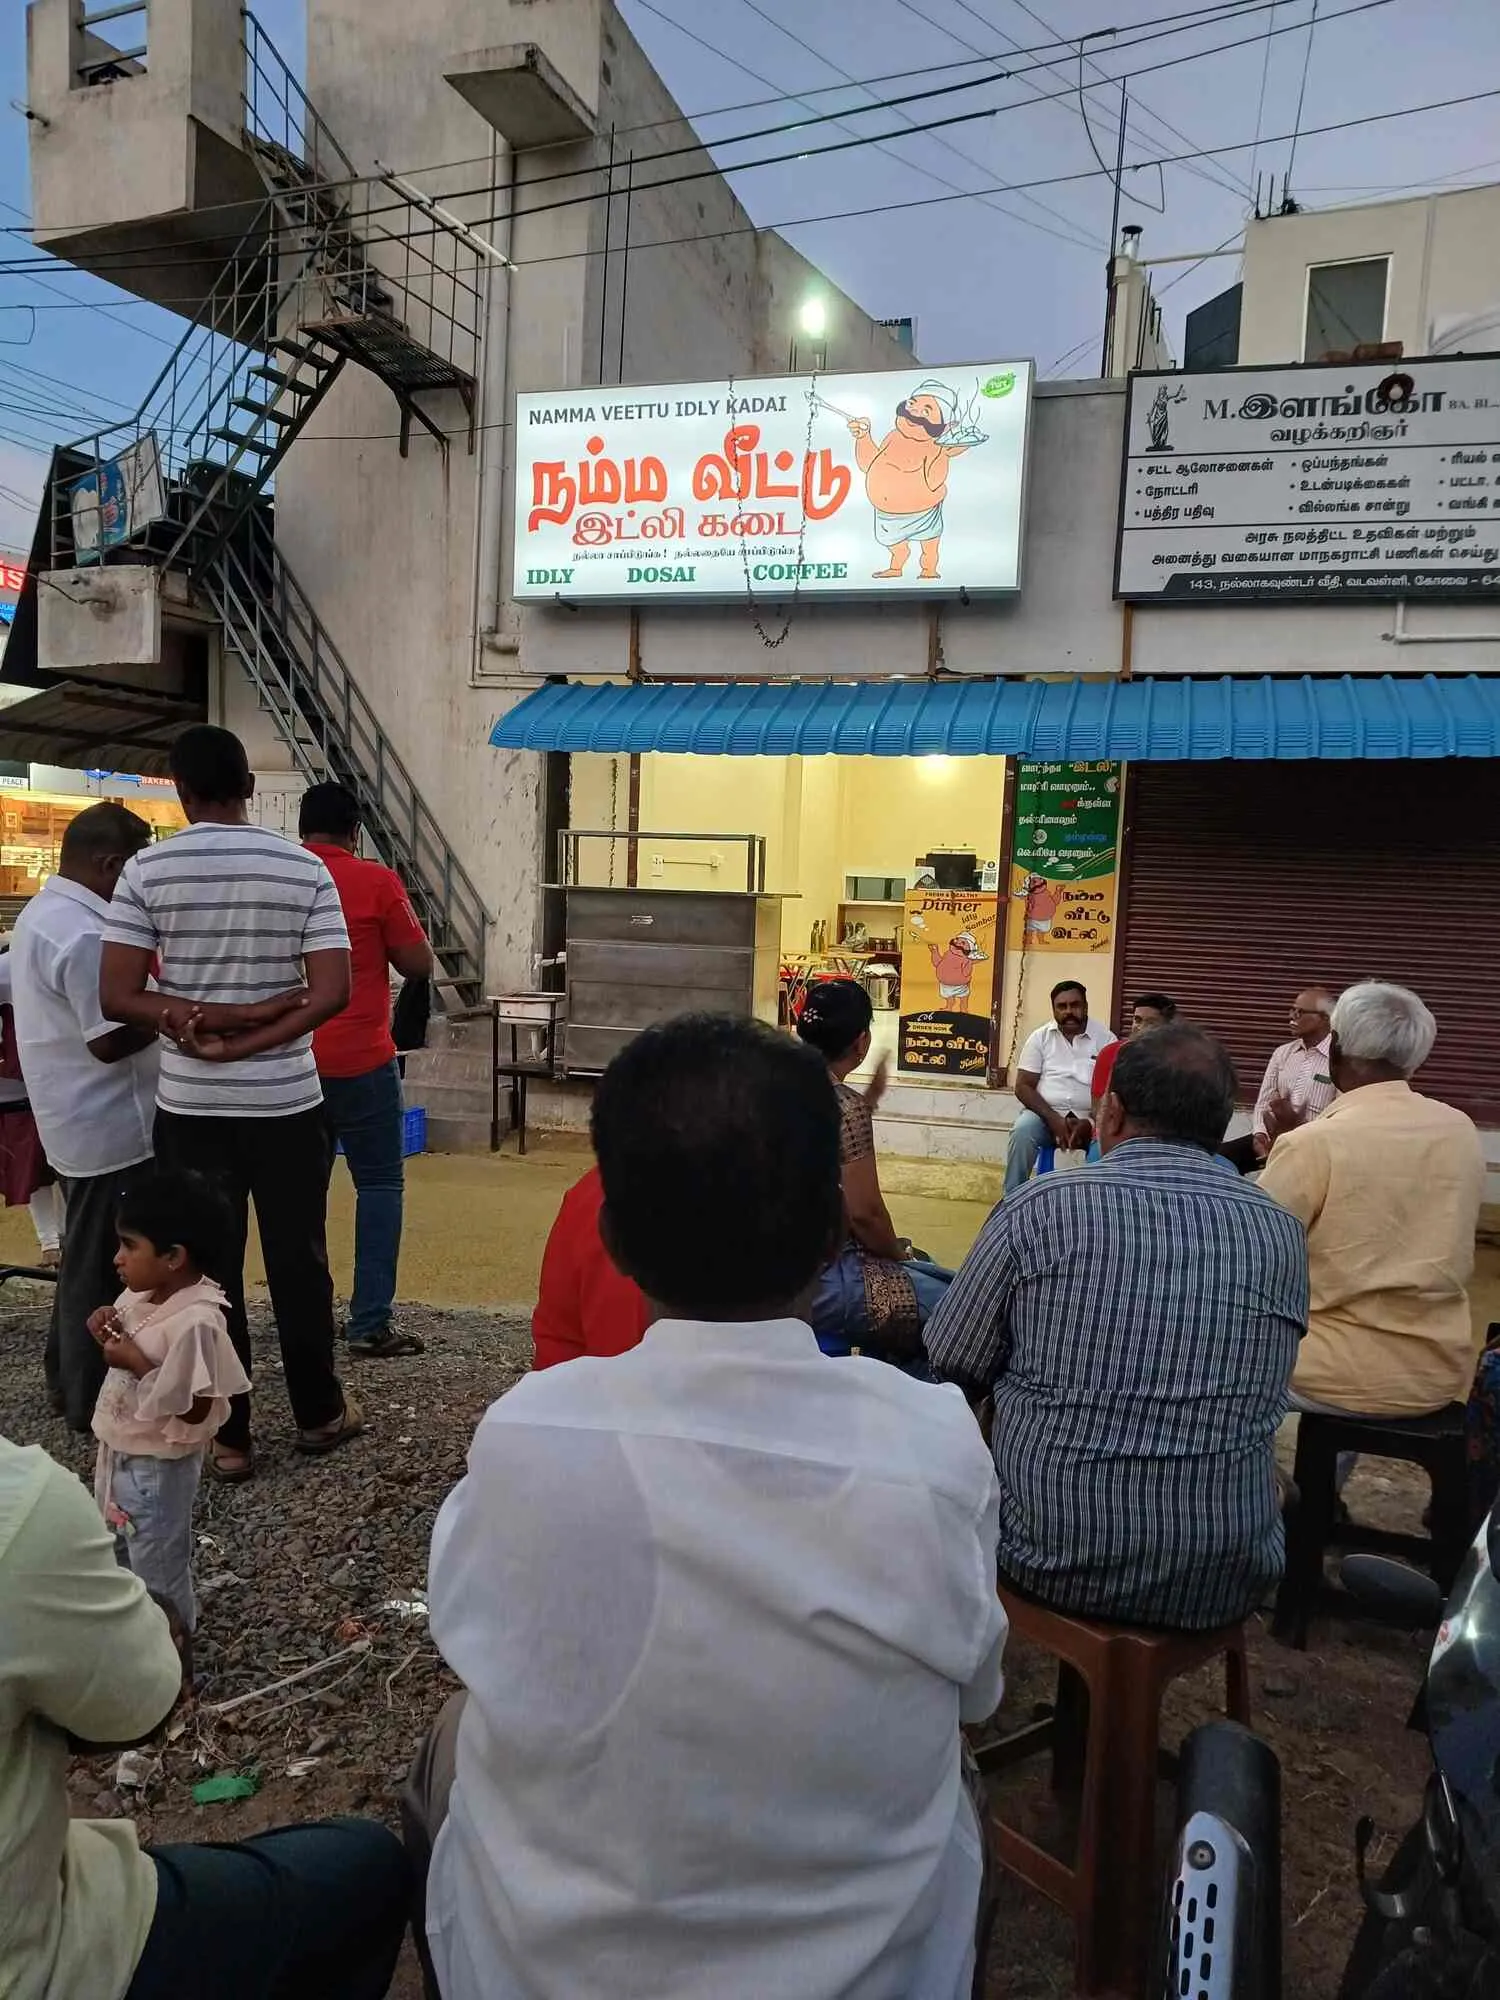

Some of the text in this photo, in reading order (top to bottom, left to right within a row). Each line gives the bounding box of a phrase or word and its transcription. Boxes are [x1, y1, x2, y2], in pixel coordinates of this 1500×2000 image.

[529, 396, 787, 425] NAMMA VEETTU IDLY KADAI
[1270, 419, 1409, 445] வழக்கறிஞர்
[1146, 458, 1275, 476] சட்ட ஆலோசனைகள்
[1302, 453, 1389, 473] ஒப்பந்தங்கள்
[528, 424, 852, 533] நம்ம வீட்டு
[1299, 475, 1411, 492] உடன்படிக்கைகள்
[1145, 482, 1198, 499] நோட்டரி
[1143, 504, 1215, 521] பத்திர பதிவு
[1365, 498, 1411, 516] சான்று
[572, 507, 805, 546] இட்லி கடை
[1245, 532, 1280, 545] அரசு
[1352, 525, 1420, 543] உதவிகள்
[1424, 525, 1477, 543] மற்றும்
[1151, 551, 1217, 568] அனைத்து
[1221, 550, 1295, 564] வகையான
[1299, 546, 1380, 564] மாநகராட்சி
[1385, 545, 1444, 560] பணிகள்
[526, 568, 575, 584] IDLY
[626, 566, 696, 583] DOSAI
[753, 562, 848, 581] COFFEE
[1414, 575, 1468, 586] கோவை
[921, 898, 982, 912] Dinner
